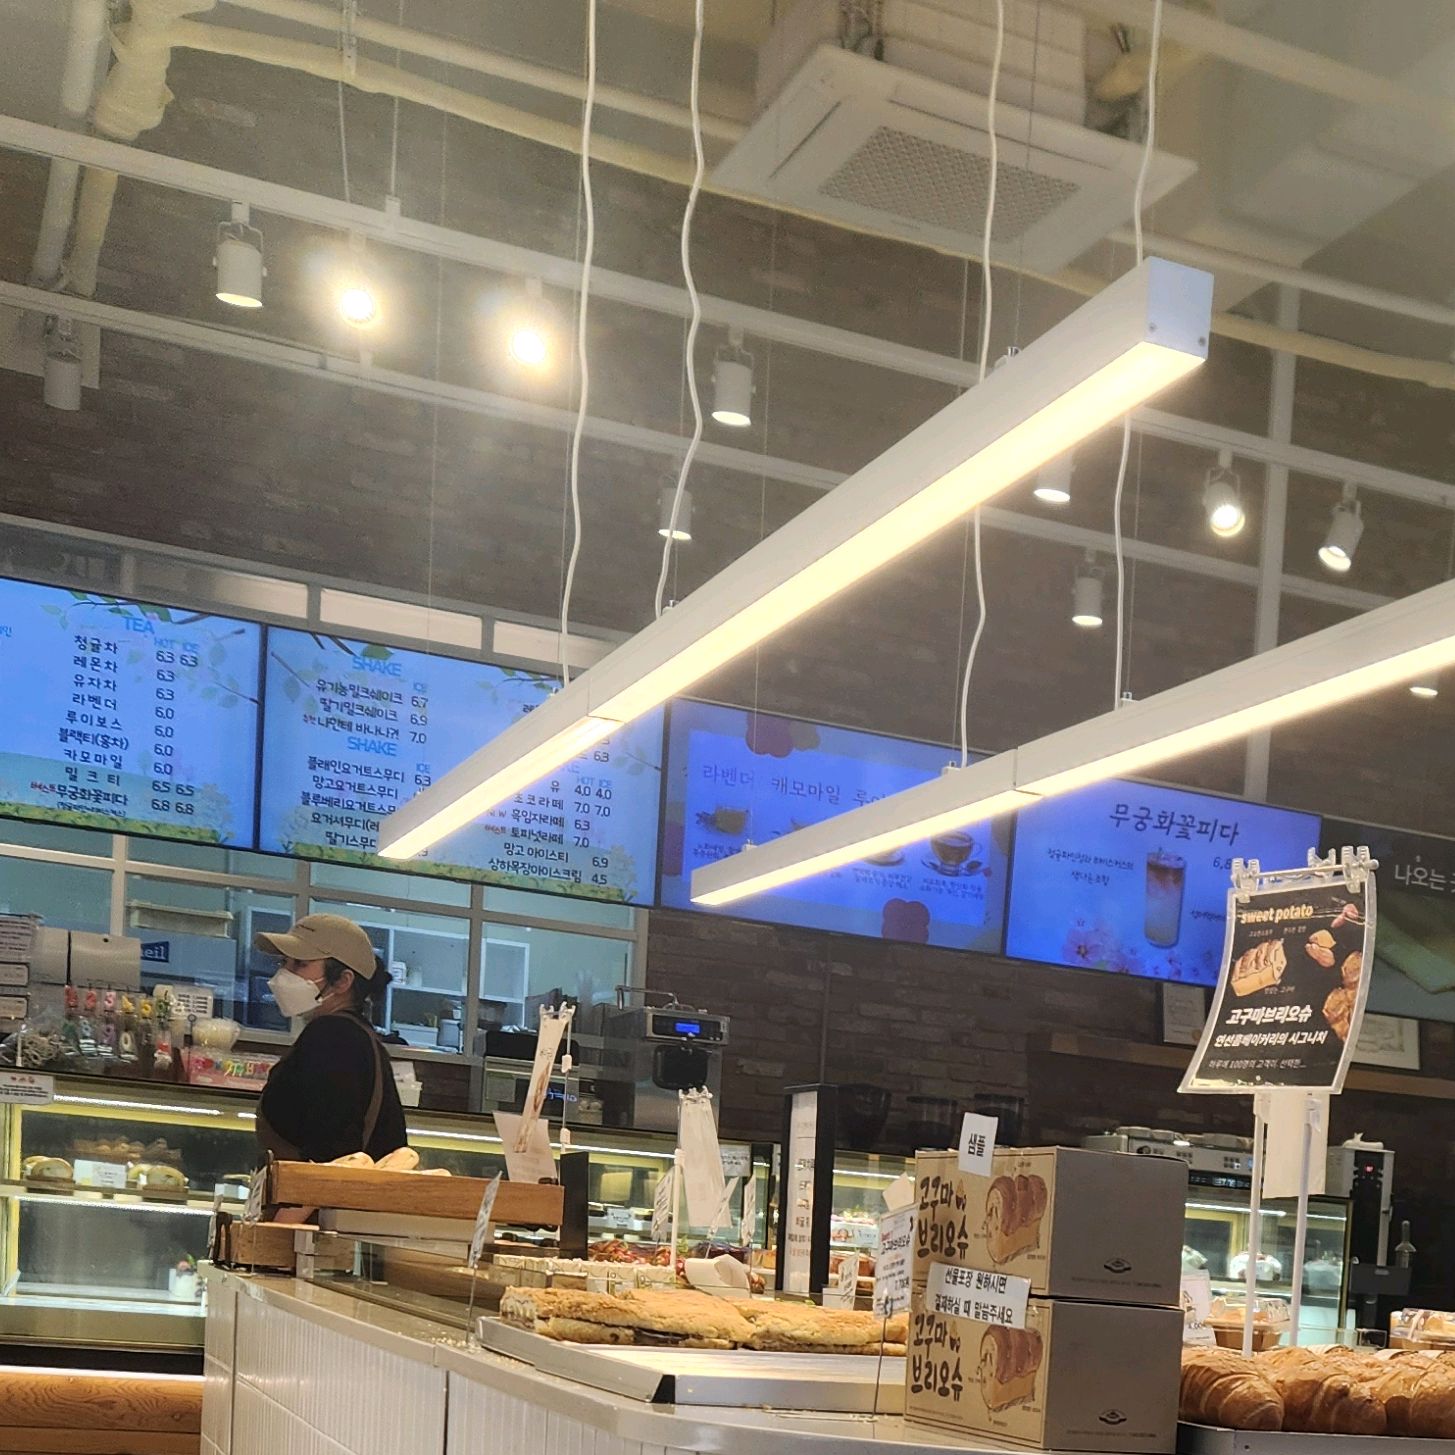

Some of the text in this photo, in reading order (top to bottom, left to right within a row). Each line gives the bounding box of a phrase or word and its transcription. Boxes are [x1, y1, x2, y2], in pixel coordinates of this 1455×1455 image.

[123, 616, 155, 635] TEA
[73, 655, 119, 674] 레몬차
[352, 655, 402, 677] SHAKE
[73, 673, 118, 692] 유자차
[72, 693, 118, 711] 라벤더
[65, 709, 123, 731] 루이보스
[58, 727, 129, 751] 블랙티(홍차)
[346, 735, 398, 757] SHAKE
[63, 748, 123, 770] 카모마일
[65, 766, 121, 787] 밀크티
[312, 774, 399, 800] 망고요거트스무디
[703, 764, 755, 787] 라벤더
[771, 775, 841, 806] 캐모마일
[301, 790, 397, 816] 블루베리요거트스무
[511, 808, 565, 829] 흑임자라떼
[1109, 803, 1240, 846] 무궁화꽃피다
[503, 841, 525, 857] 망고
[527, 846, 569, 864] 아이스티
[1394, 863, 1447, 891] 나오는
[1240, 906, 1275, 925] sweet
[1274, 903, 1314, 924] potato
[1225, 1004, 1313, 1026] 고구마브리오슈
[917, 1213, 970, 1261] 브리오슈
[944, 1267, 1008, 1294] 선물포장 원하시면
[910, 1354, 964, 1402] 브리오슈
